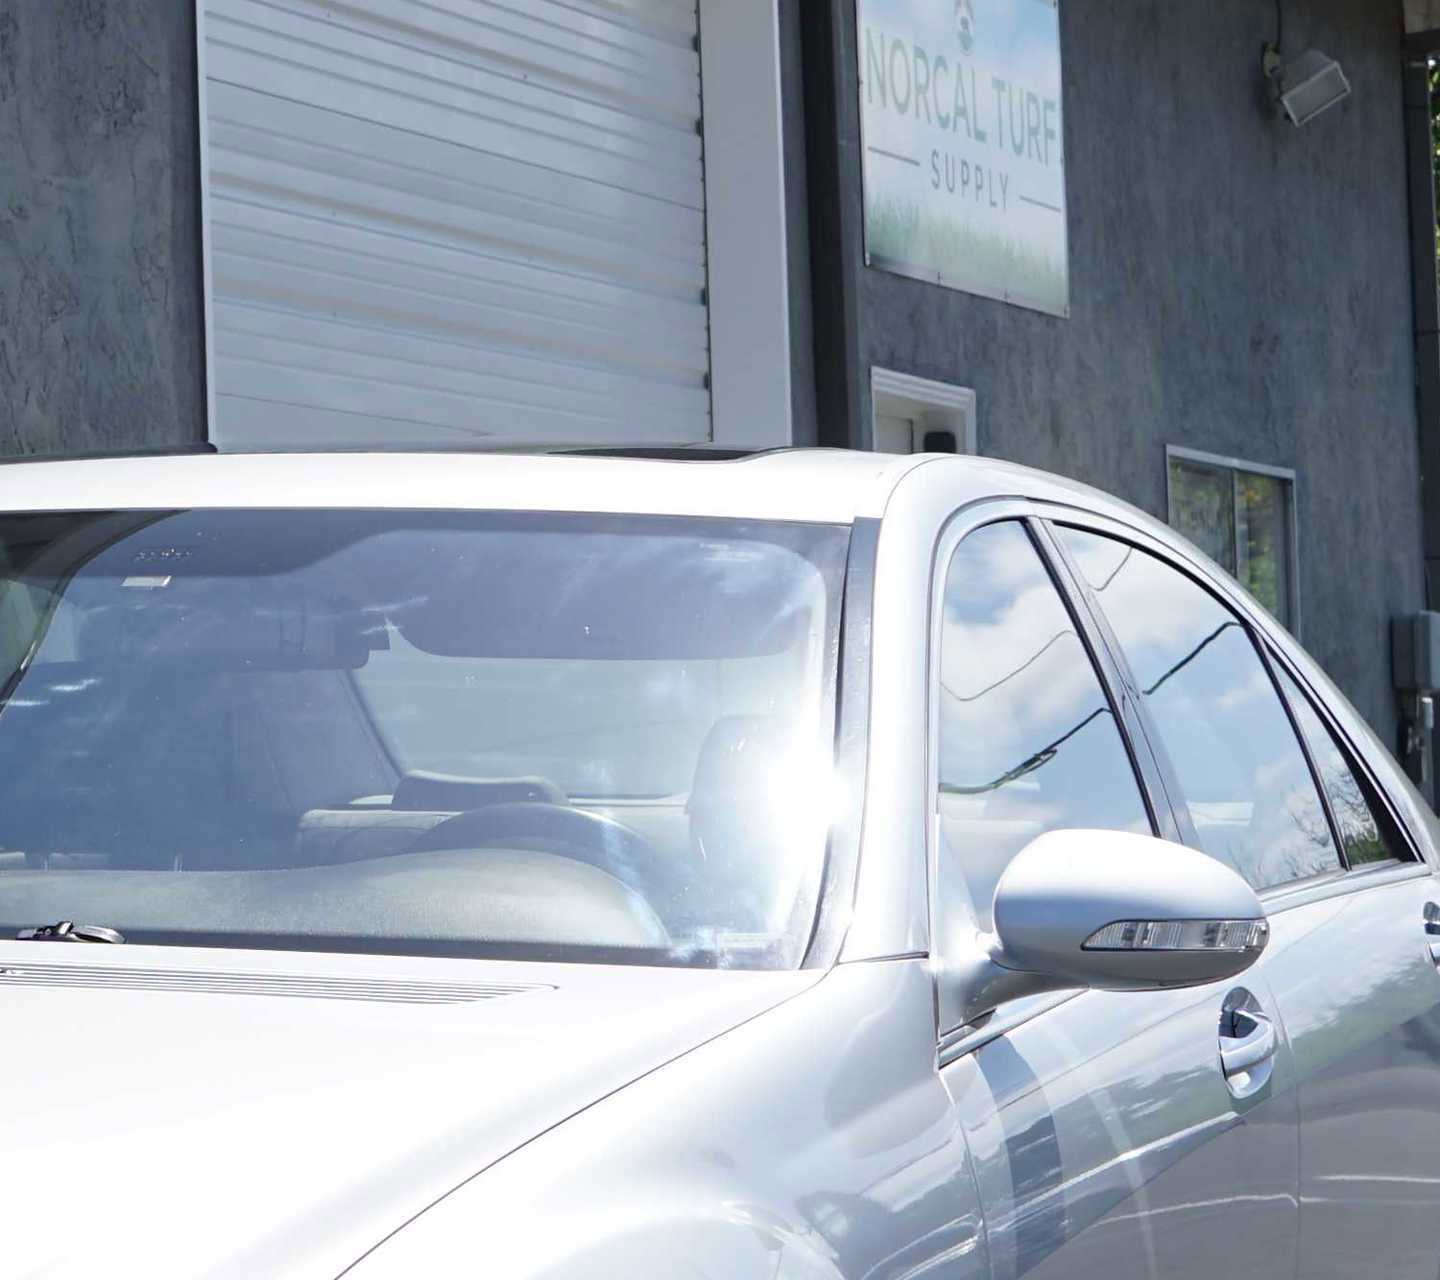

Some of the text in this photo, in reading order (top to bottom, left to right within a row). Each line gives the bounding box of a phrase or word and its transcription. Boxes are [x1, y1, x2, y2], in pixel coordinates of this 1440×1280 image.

[865, 28, 1057, 167] NORCAL TURF
[931, 149, 1009, 211] SUPPLY
